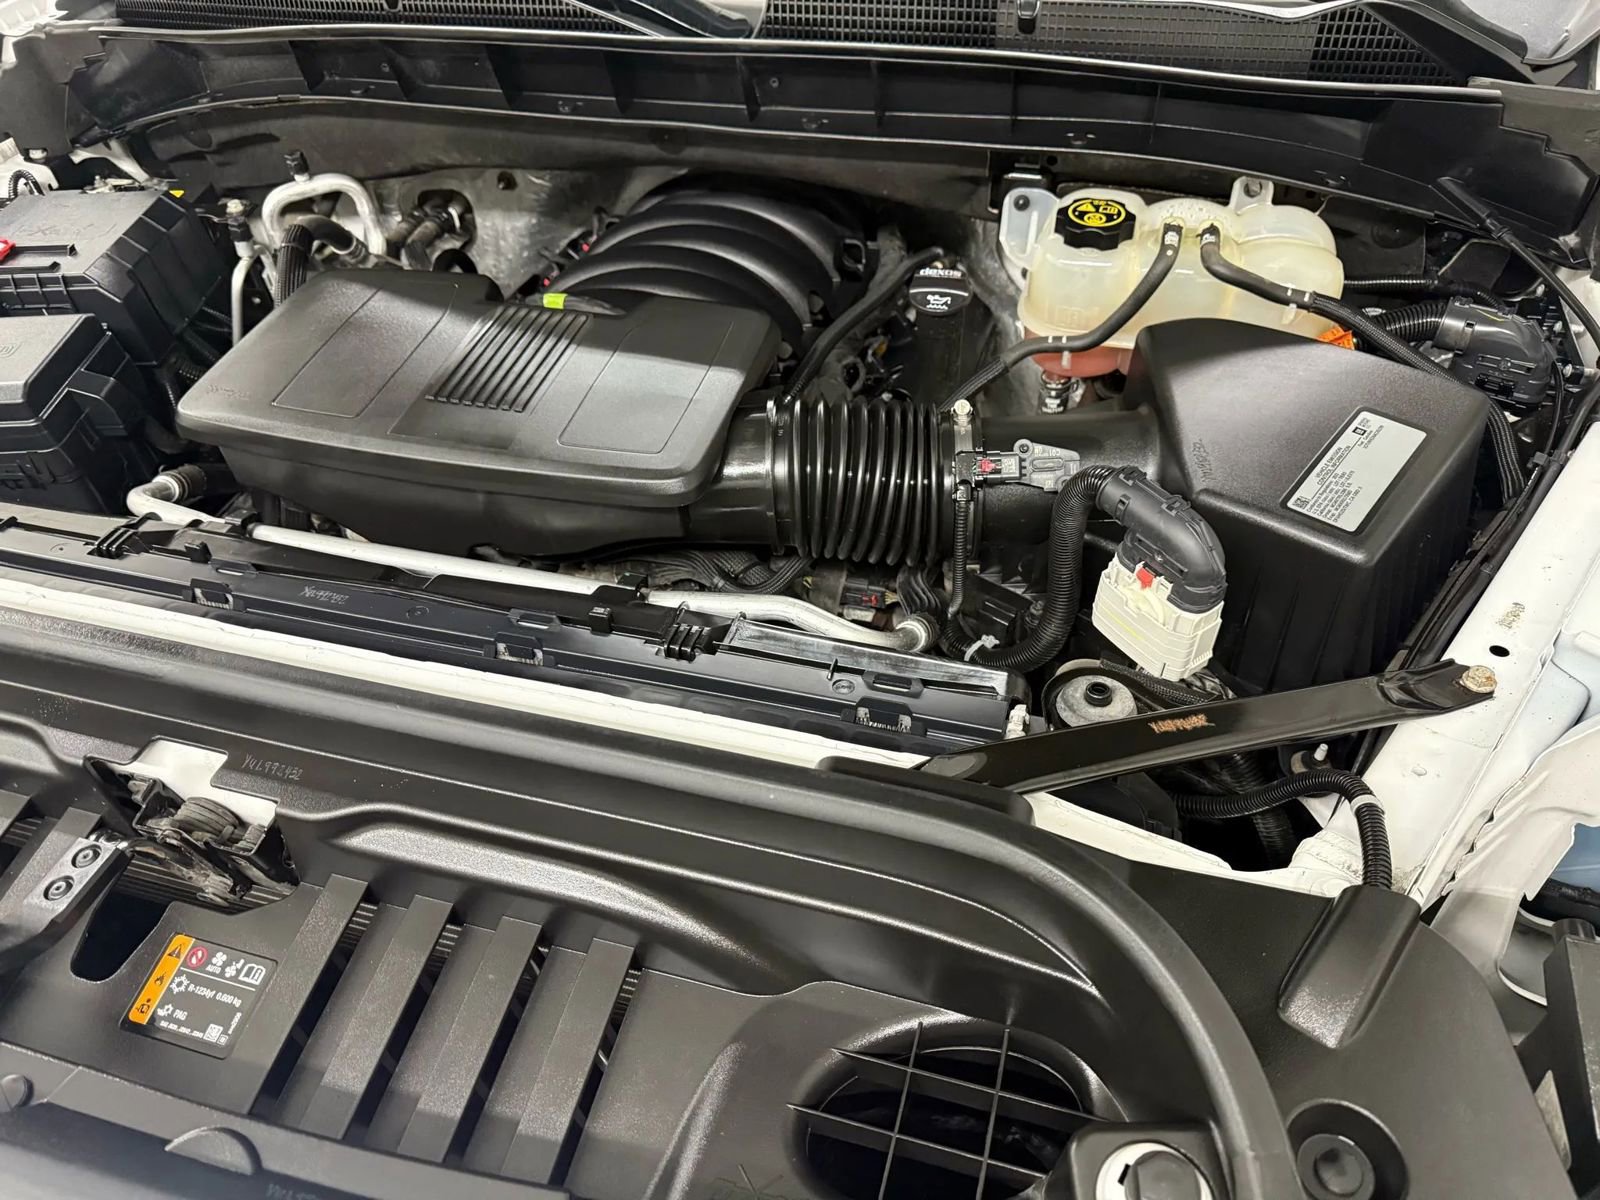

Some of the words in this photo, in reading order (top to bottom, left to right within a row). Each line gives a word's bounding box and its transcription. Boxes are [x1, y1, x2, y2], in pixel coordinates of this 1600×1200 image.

[920, 267, 962, 279] dexos
[1315, 463, 1329, 478] VEHICLE
[1327, 447, 1342, 463] EMISSION
[1316, 468, 1332, 485] CONTROL
[1330, 445, 1350, 467] INFORMATION
[205, 964, 221, 974] AUTO
[173, 1009, 188, 1020] PAG
